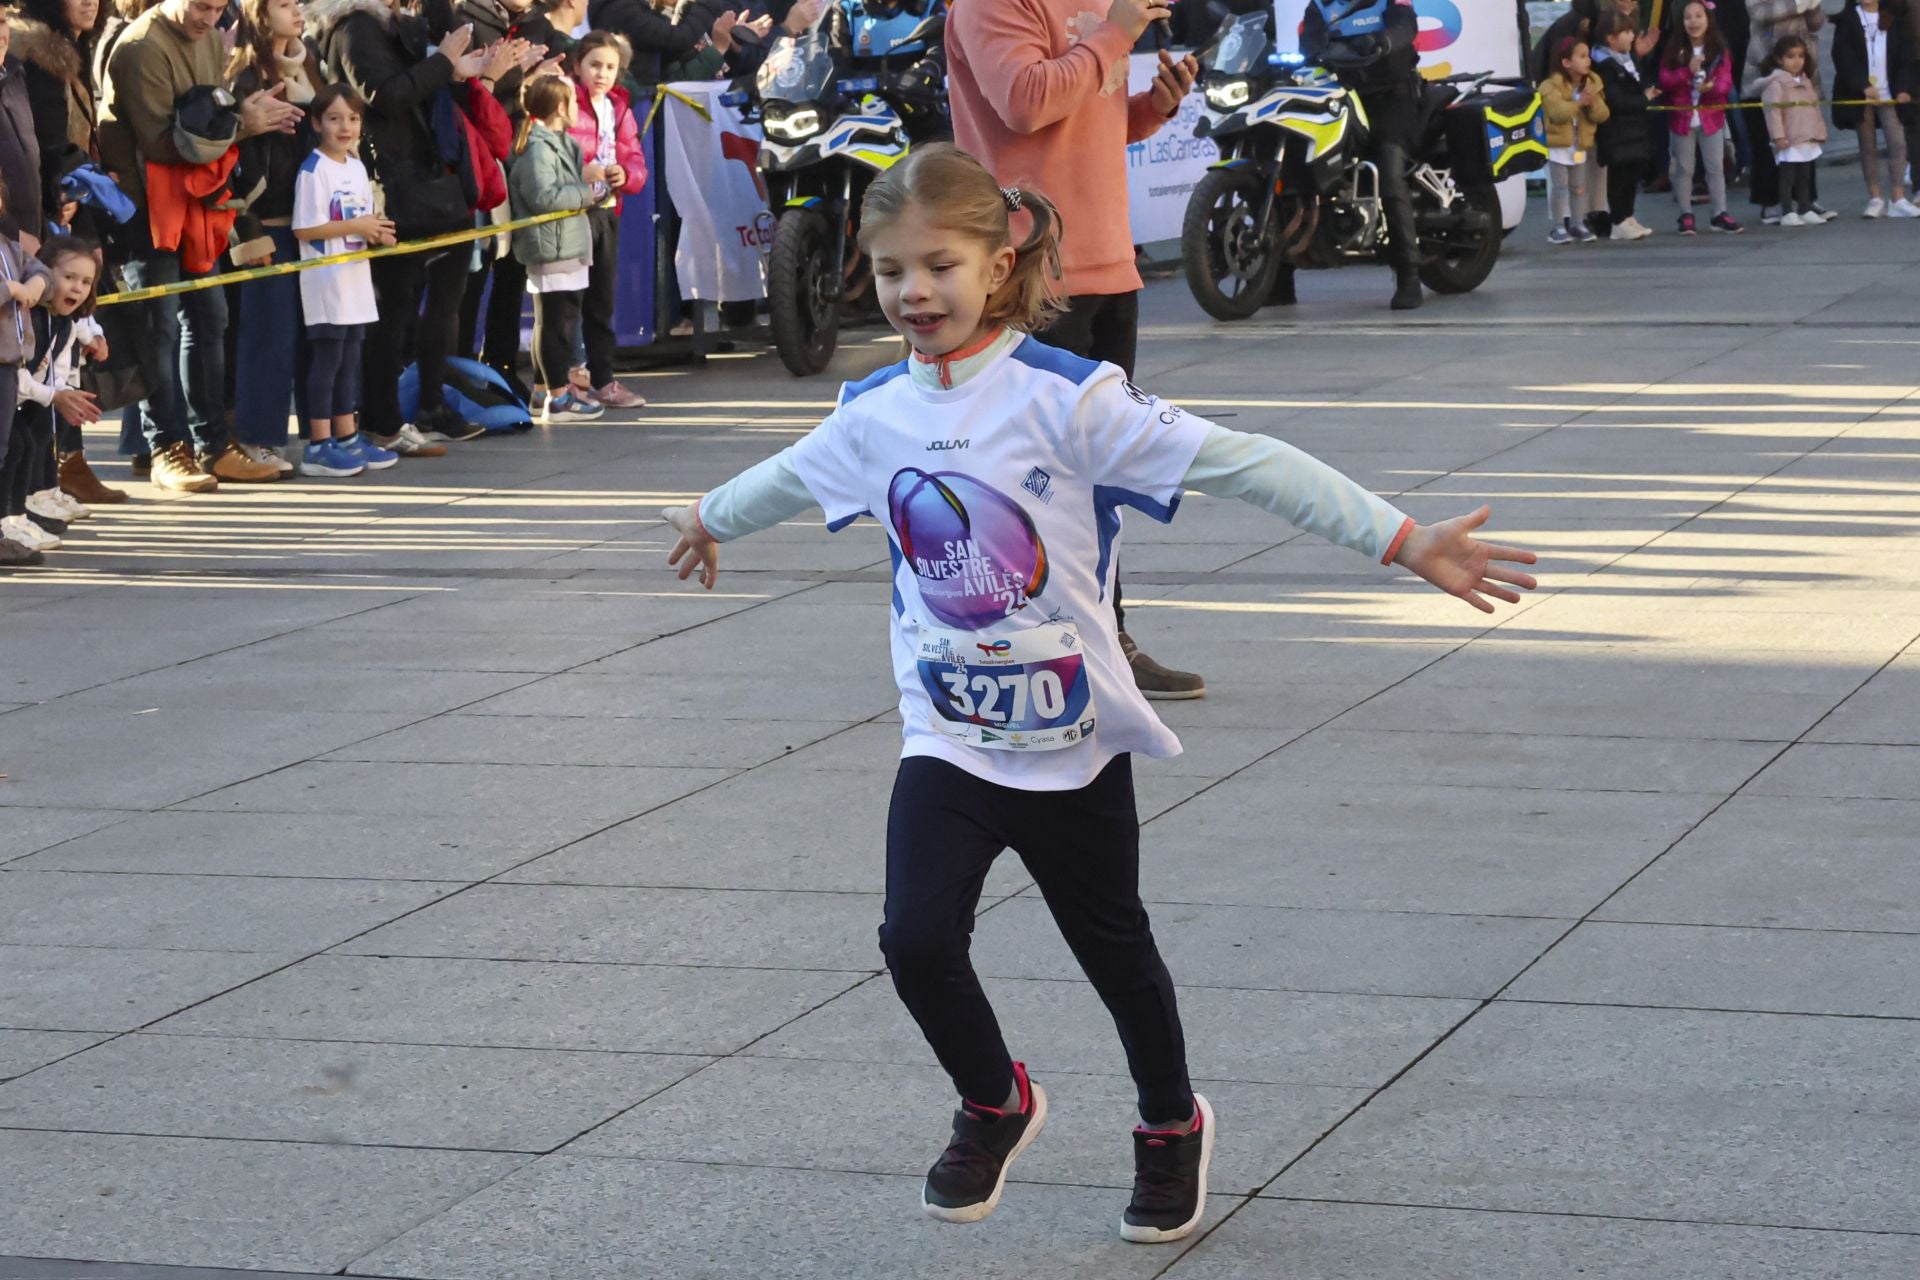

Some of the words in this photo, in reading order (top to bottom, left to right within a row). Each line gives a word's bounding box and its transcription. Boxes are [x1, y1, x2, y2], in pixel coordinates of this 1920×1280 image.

[944, 539, 981, 559] SAN
[917, 557, 994, 579] SILVESTRE
[964, 569, 1025, 597] AVILÉS
[942, 670, 1065, 721] 3270
[1030, 736, 1055, 745] Cyasa
